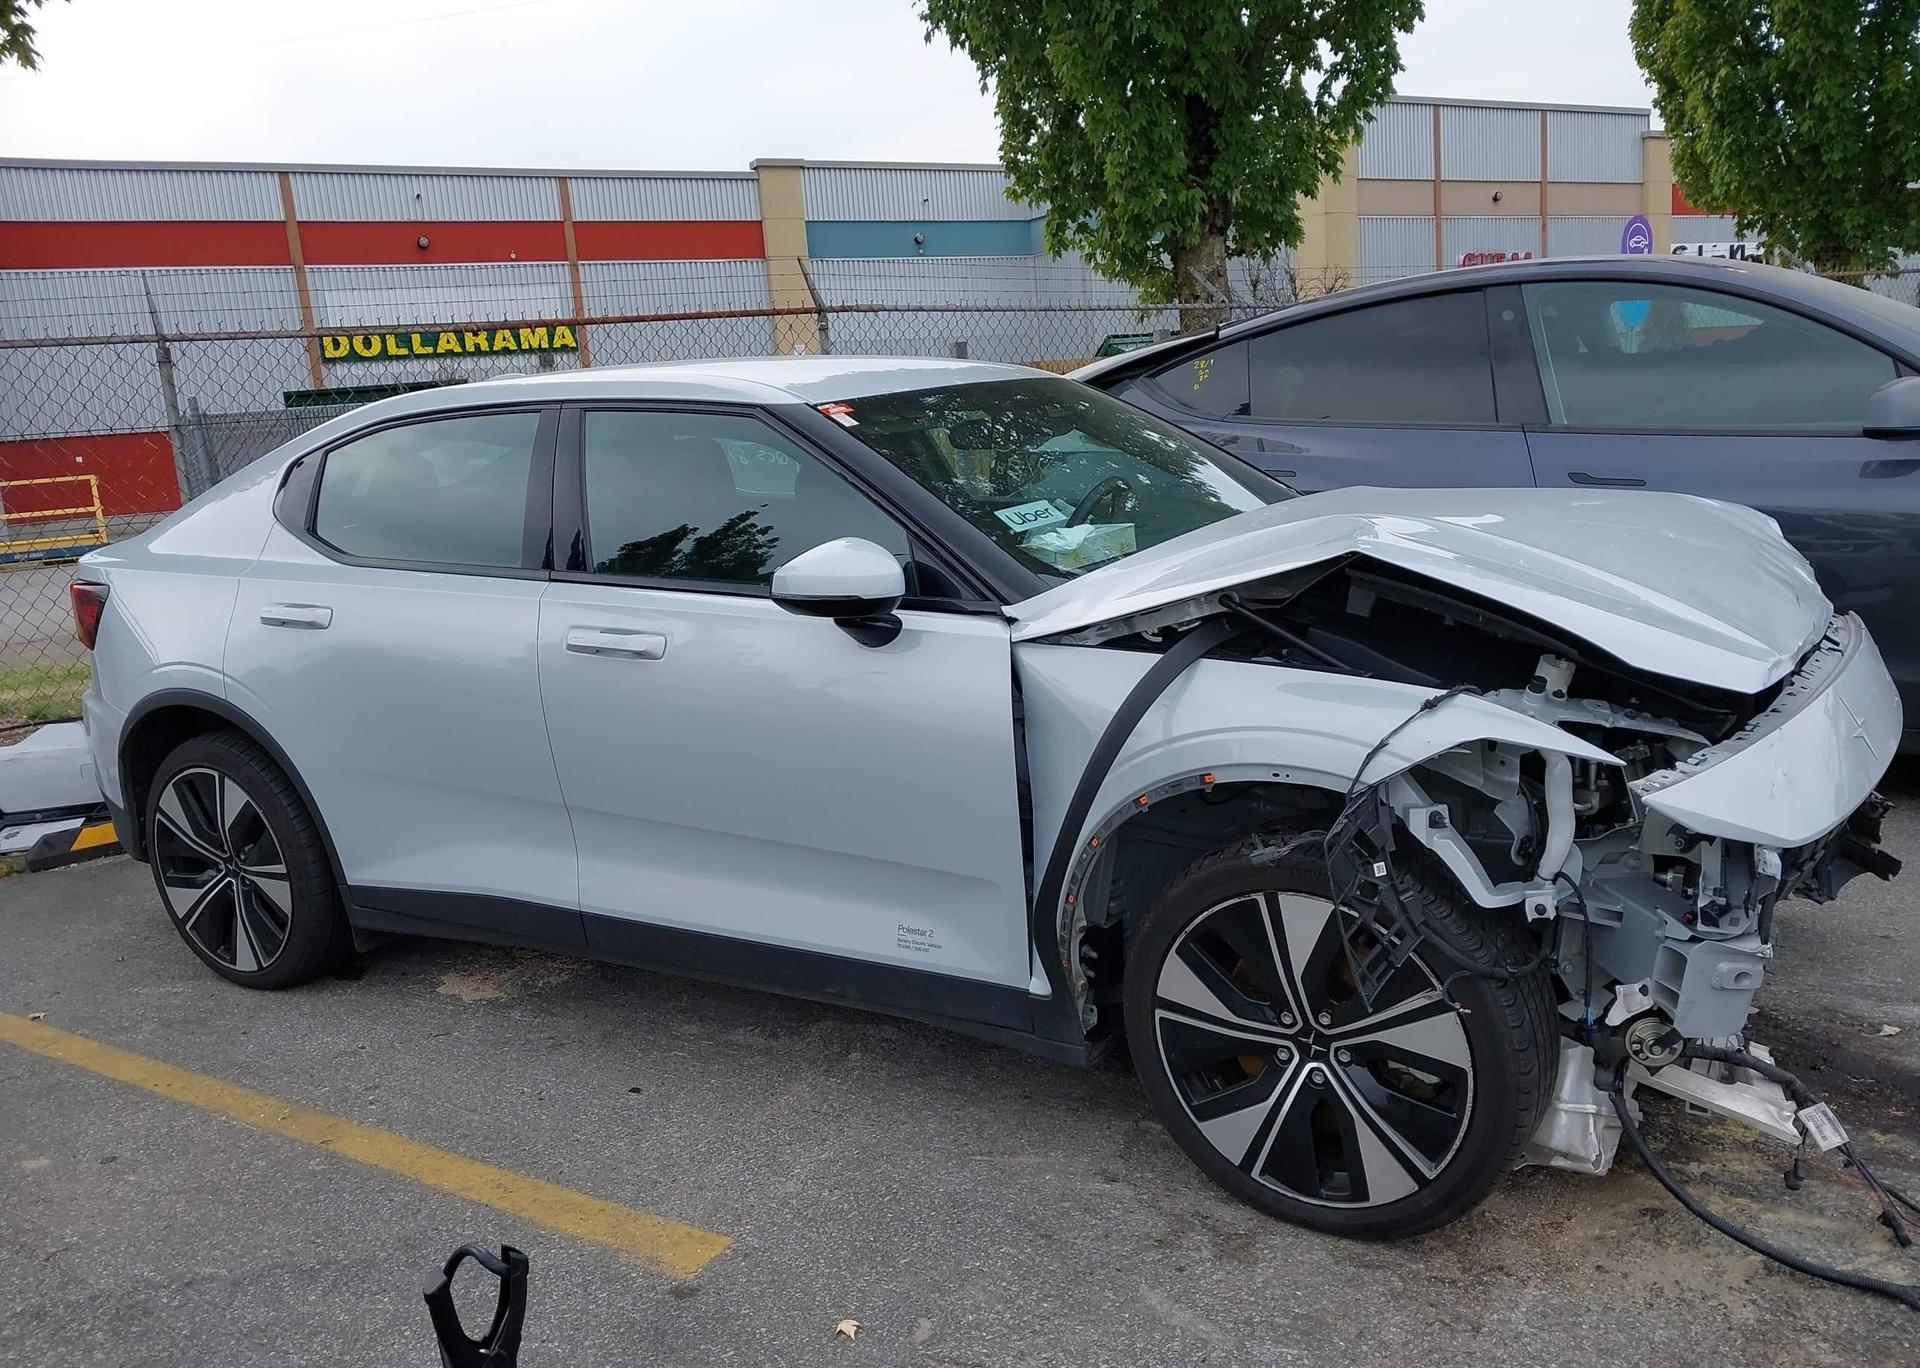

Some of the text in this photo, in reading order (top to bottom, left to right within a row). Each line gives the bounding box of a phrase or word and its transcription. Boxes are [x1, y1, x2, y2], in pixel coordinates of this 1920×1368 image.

[323, 326, 577, 358] DOLLARAMA
[1004, 506, 1055, 526] Uber
[898, 924, 934, 938] Polestar 2
